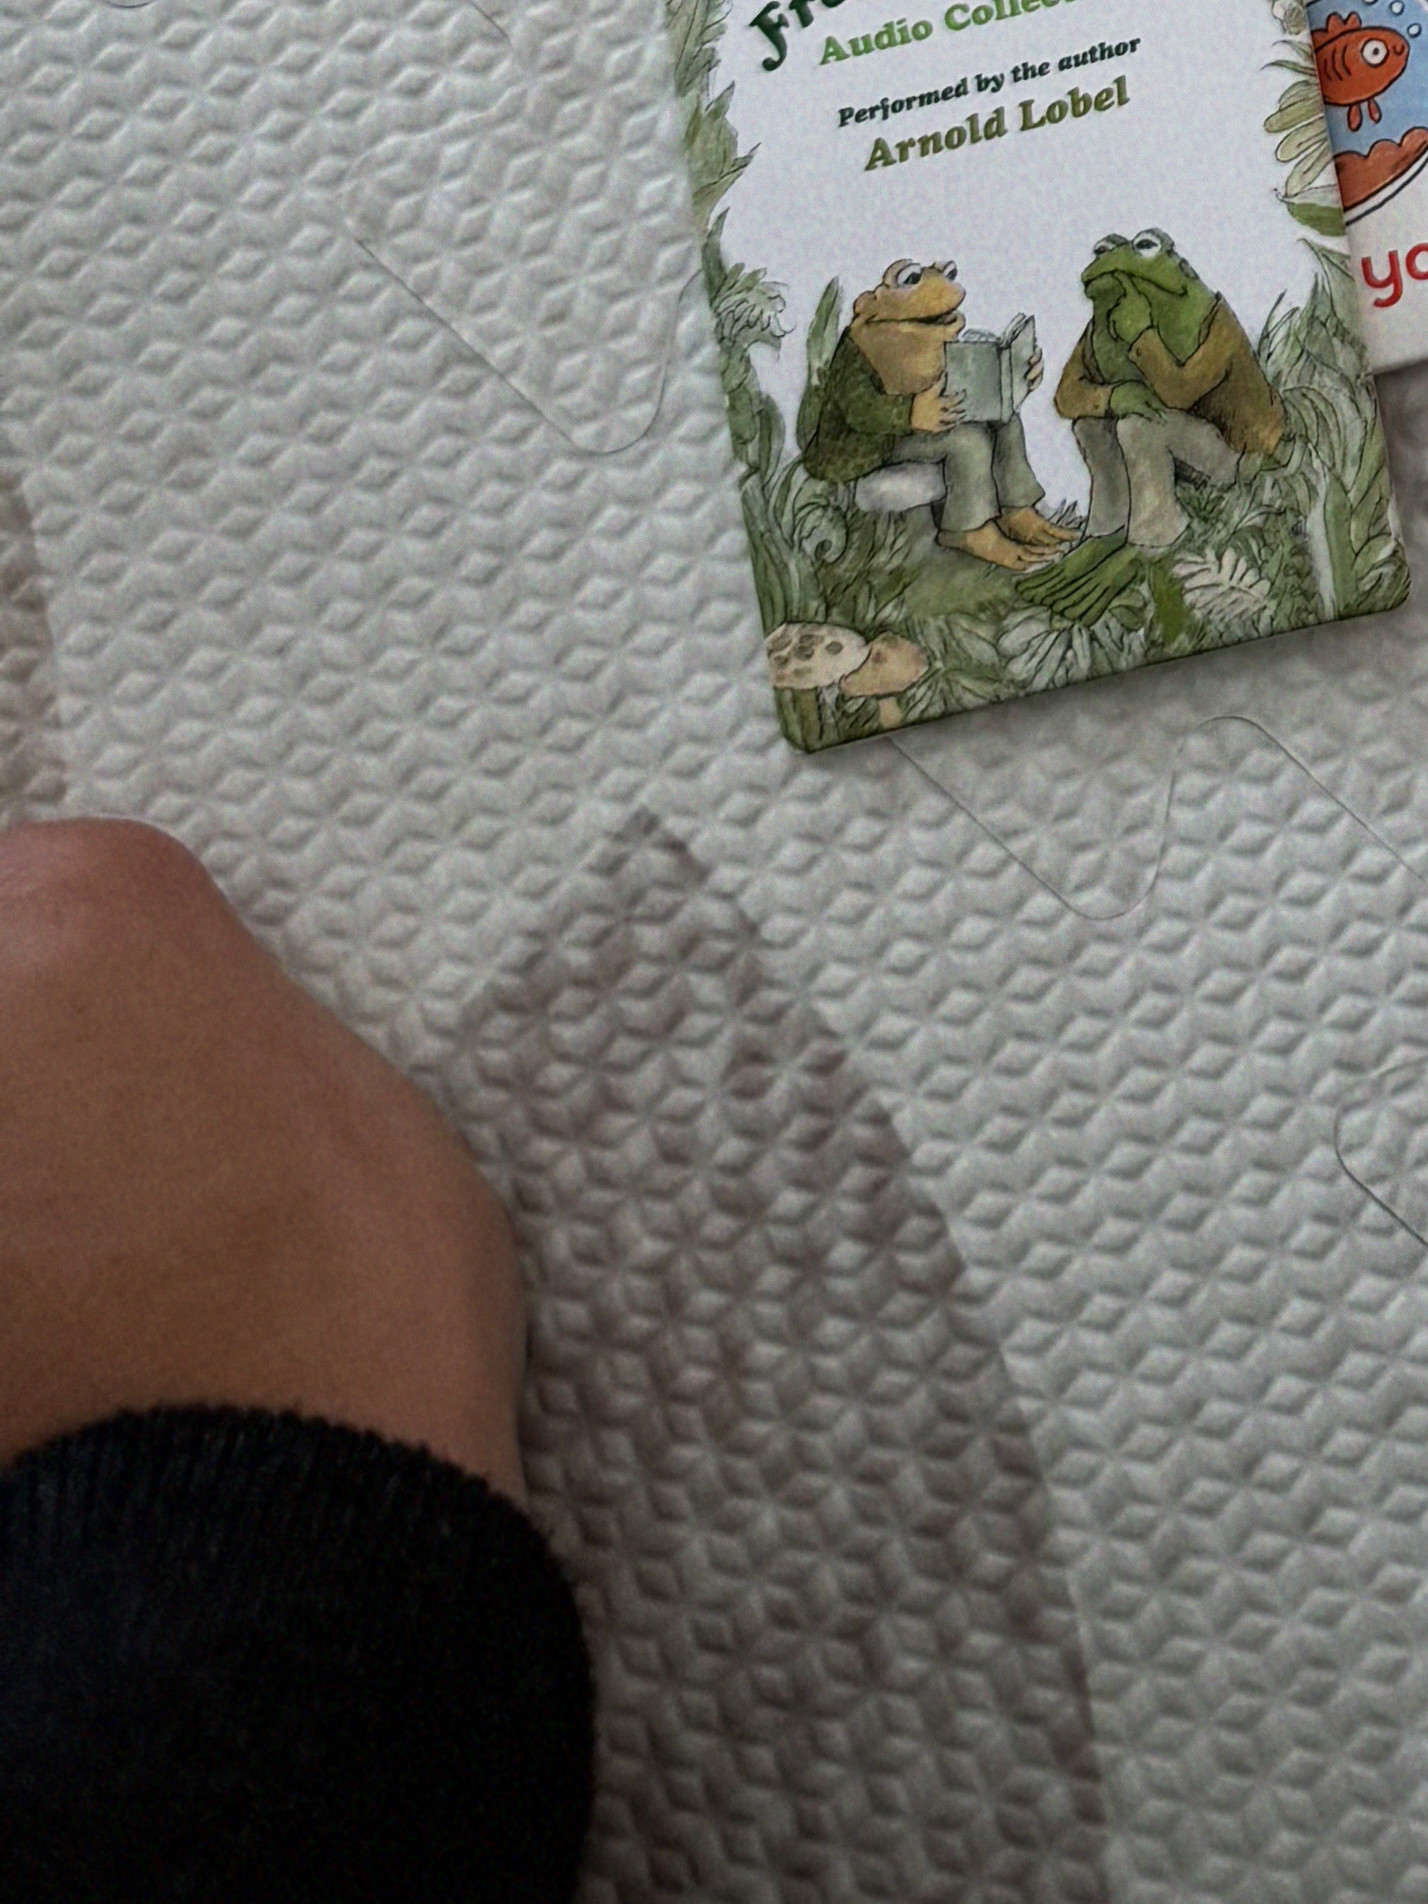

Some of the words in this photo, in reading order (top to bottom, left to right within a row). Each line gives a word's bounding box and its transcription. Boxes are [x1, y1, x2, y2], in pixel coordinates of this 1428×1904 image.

[820, 17, 933, 65] Audio
[838, 77, 968, 128] Performed
[977, 73, 1006, 94] by
[1012, 61, 1051, 83] the
[1058, 37, 1141, 72] author
[864, 106, 1008, 171] Arnold
[1019, 75, 1132, 131] Lobel
